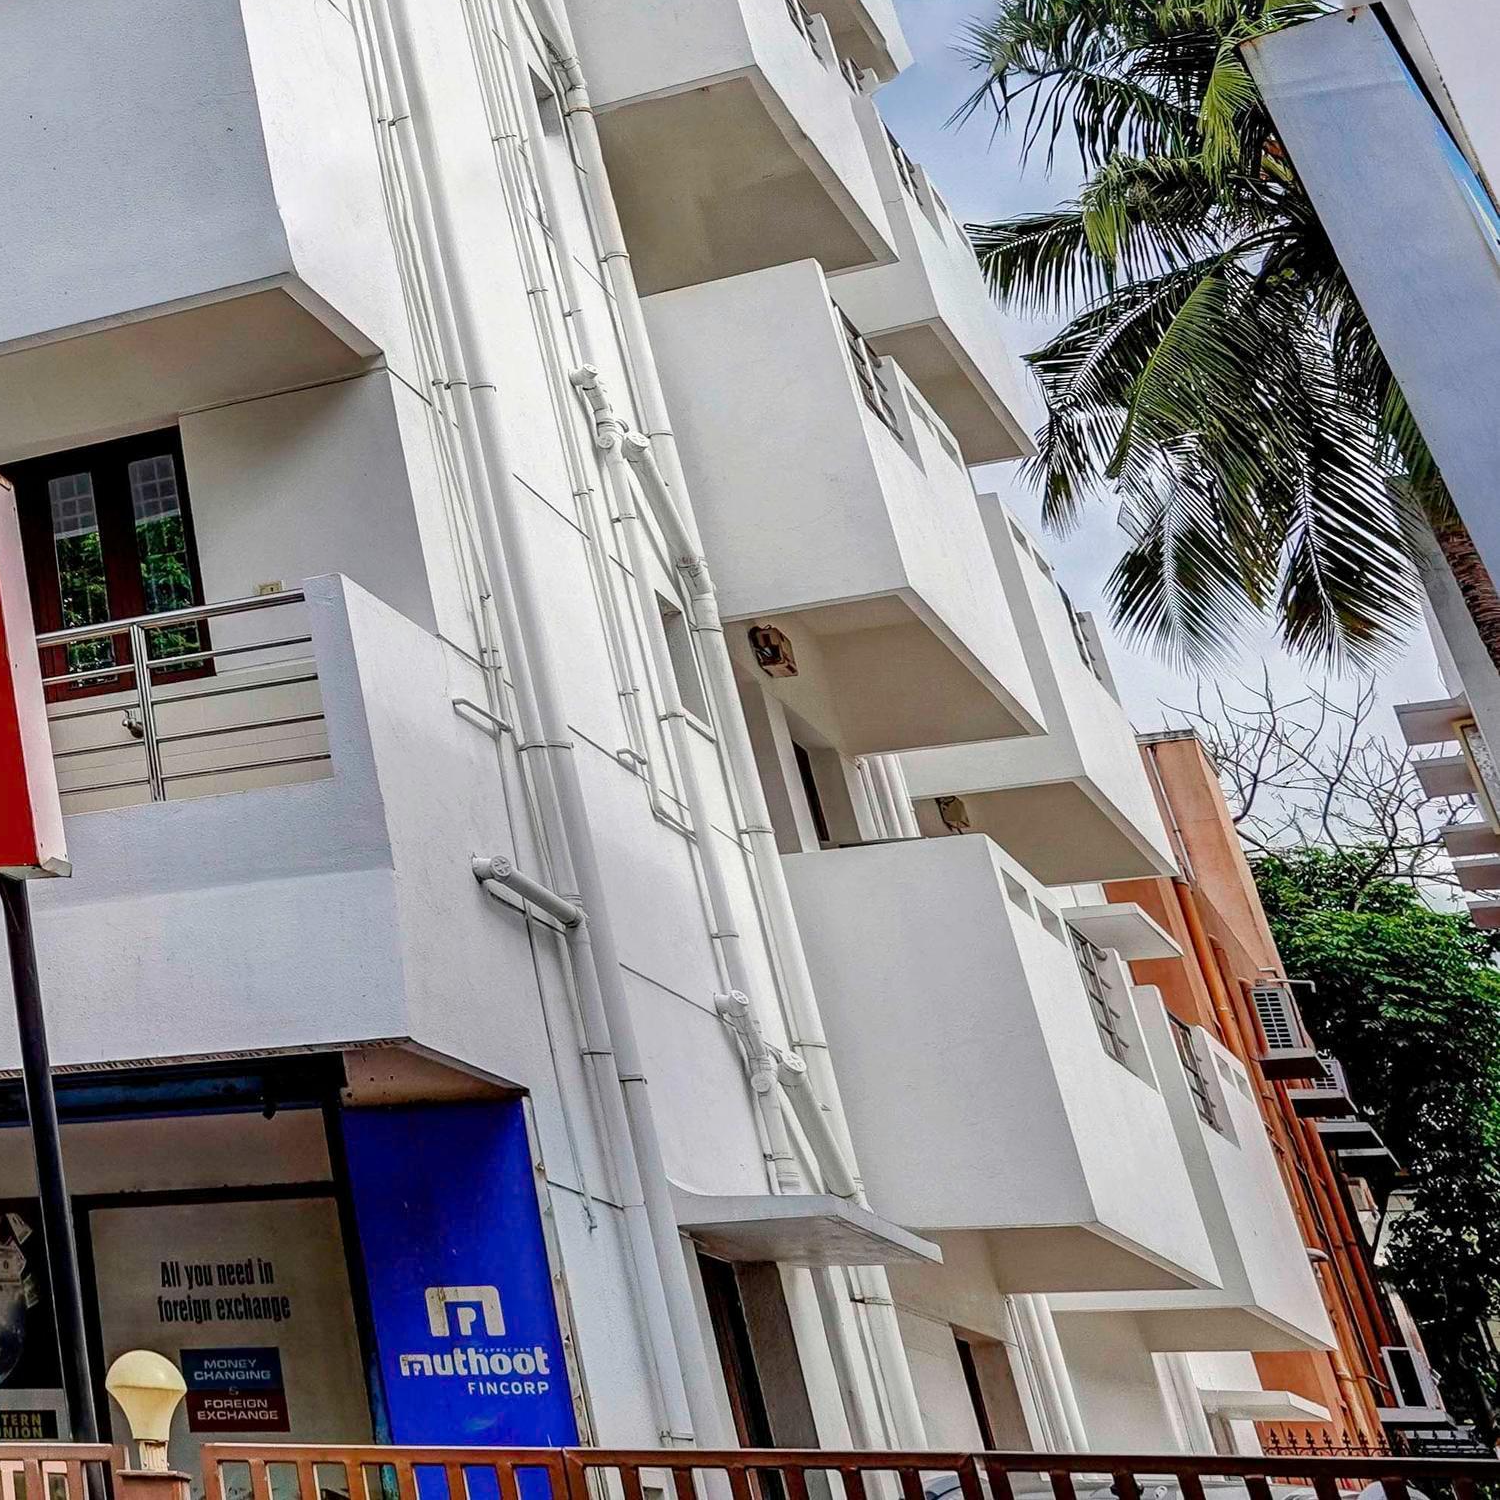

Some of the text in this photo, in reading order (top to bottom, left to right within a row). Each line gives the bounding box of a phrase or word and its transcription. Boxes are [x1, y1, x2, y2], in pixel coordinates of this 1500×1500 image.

[160, 1258, 274, 1290] All you need in
[157, 1293, 291, 1325] foreign exchange
[203, 1358, 257, 1370] MONEY
[400, 1346, 550, 1377] muthoot
[193, 1369, 272, 1381] CHANGING
[467, 1381, 550, 1396] FINCORP
[204, 1398, 269, 1409] FOREIGN
[197, 1409, 281, 1421] EXCHANGE
